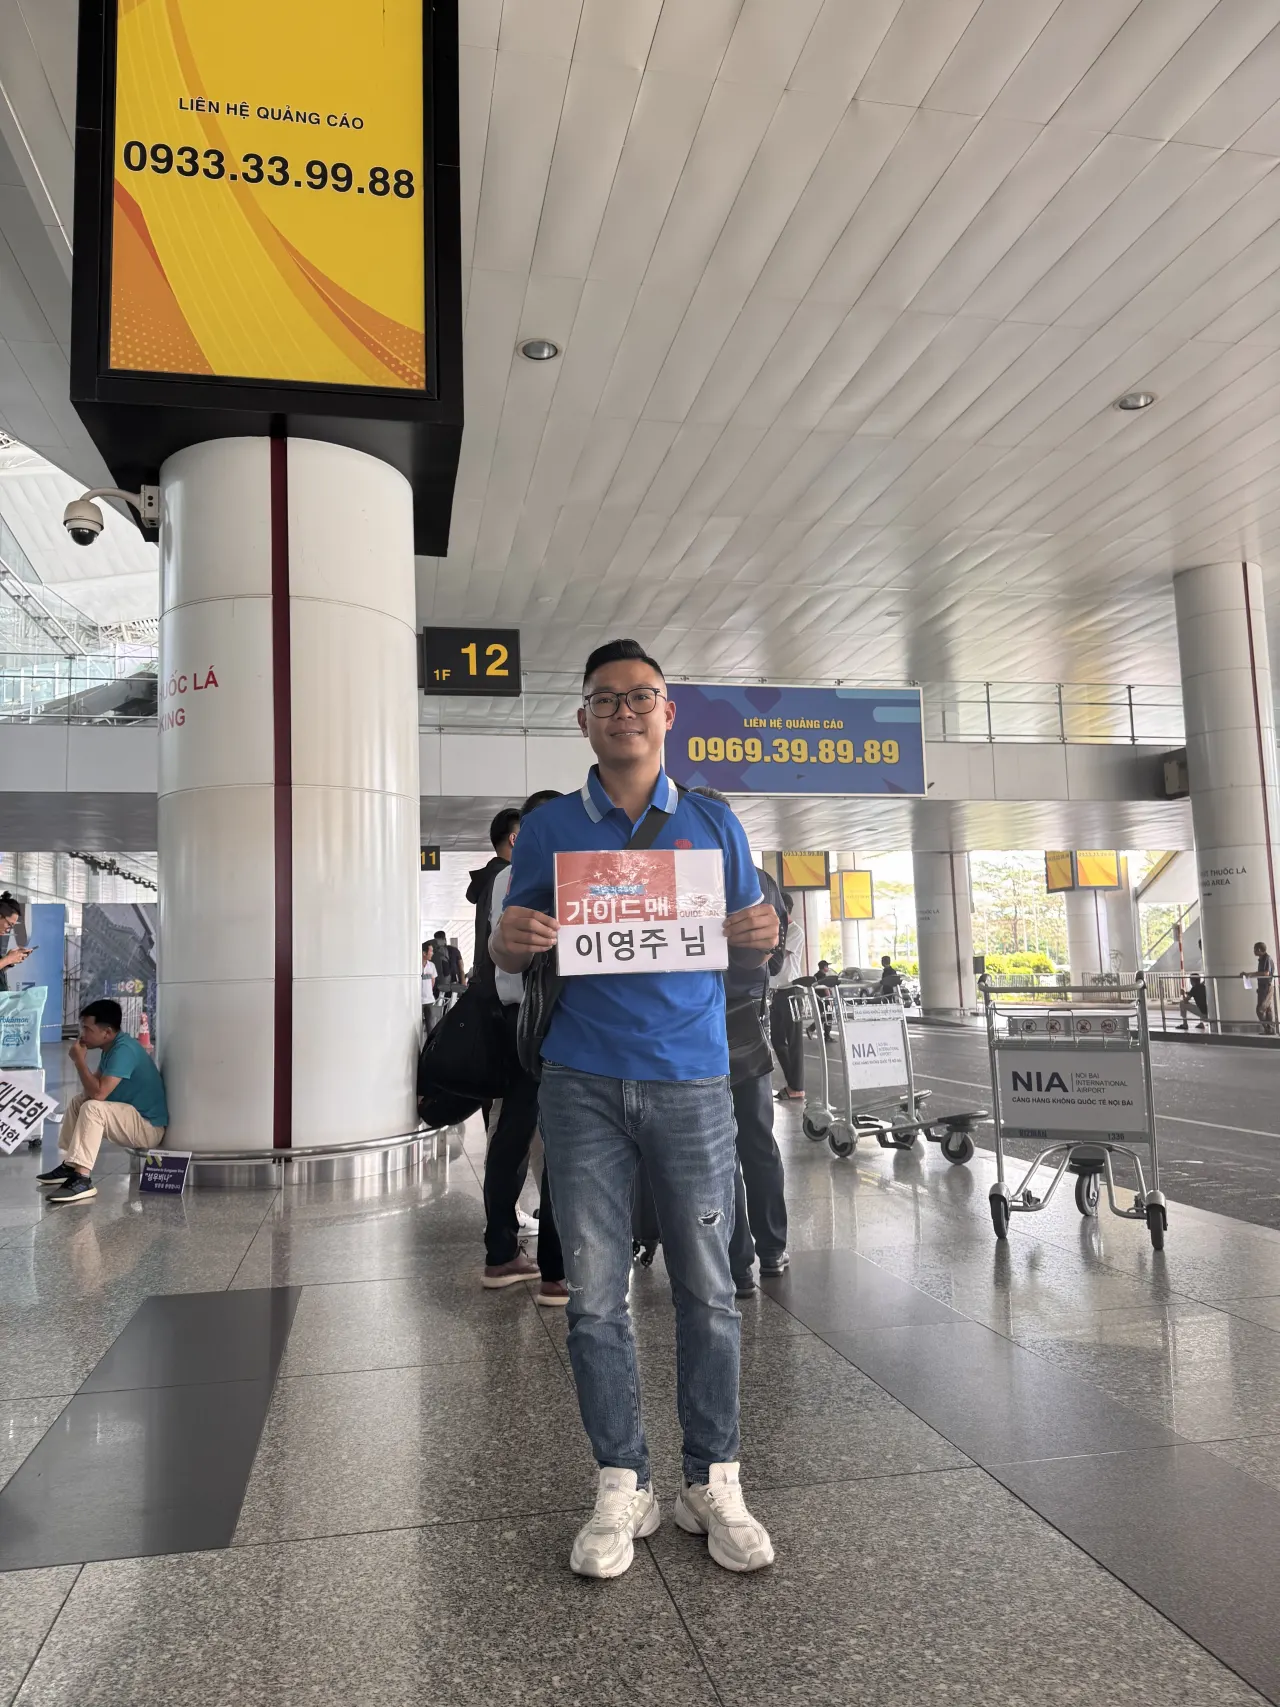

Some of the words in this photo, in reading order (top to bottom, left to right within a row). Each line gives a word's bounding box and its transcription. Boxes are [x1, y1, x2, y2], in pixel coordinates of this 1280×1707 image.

[178, 97, 220, 114] LIÊN
[226, 101, 250, 118] HỆ
[256, 105, 321, 126] QUẢNG
[326, 112, 365, 130] CÁO
[123, 140, 415, 200] 0933.33.99.88
[433, 669, 451, 681] 1F
[461, 642, 510, 677] 12
[193, 665, 219, 690] LÁ
[158, 707, 186, 736] KING
[743, 716, 767, 728] LIÊN
[769, 717, 783, 730] HỆ
[785, 716, 821, 730] QUẢNG
[823, 718, 844, 730] CÁO
[687, 736, 899, 764] 0969.39.89.89
[1211, 878, 1231, 886] AREA
[576, 929, 668, 963] 이영주
[680, 925, 706, 957] 님
[852, 1043, 877, 1058] NIA
[1011, 1070, 1069, 1093] NIA
